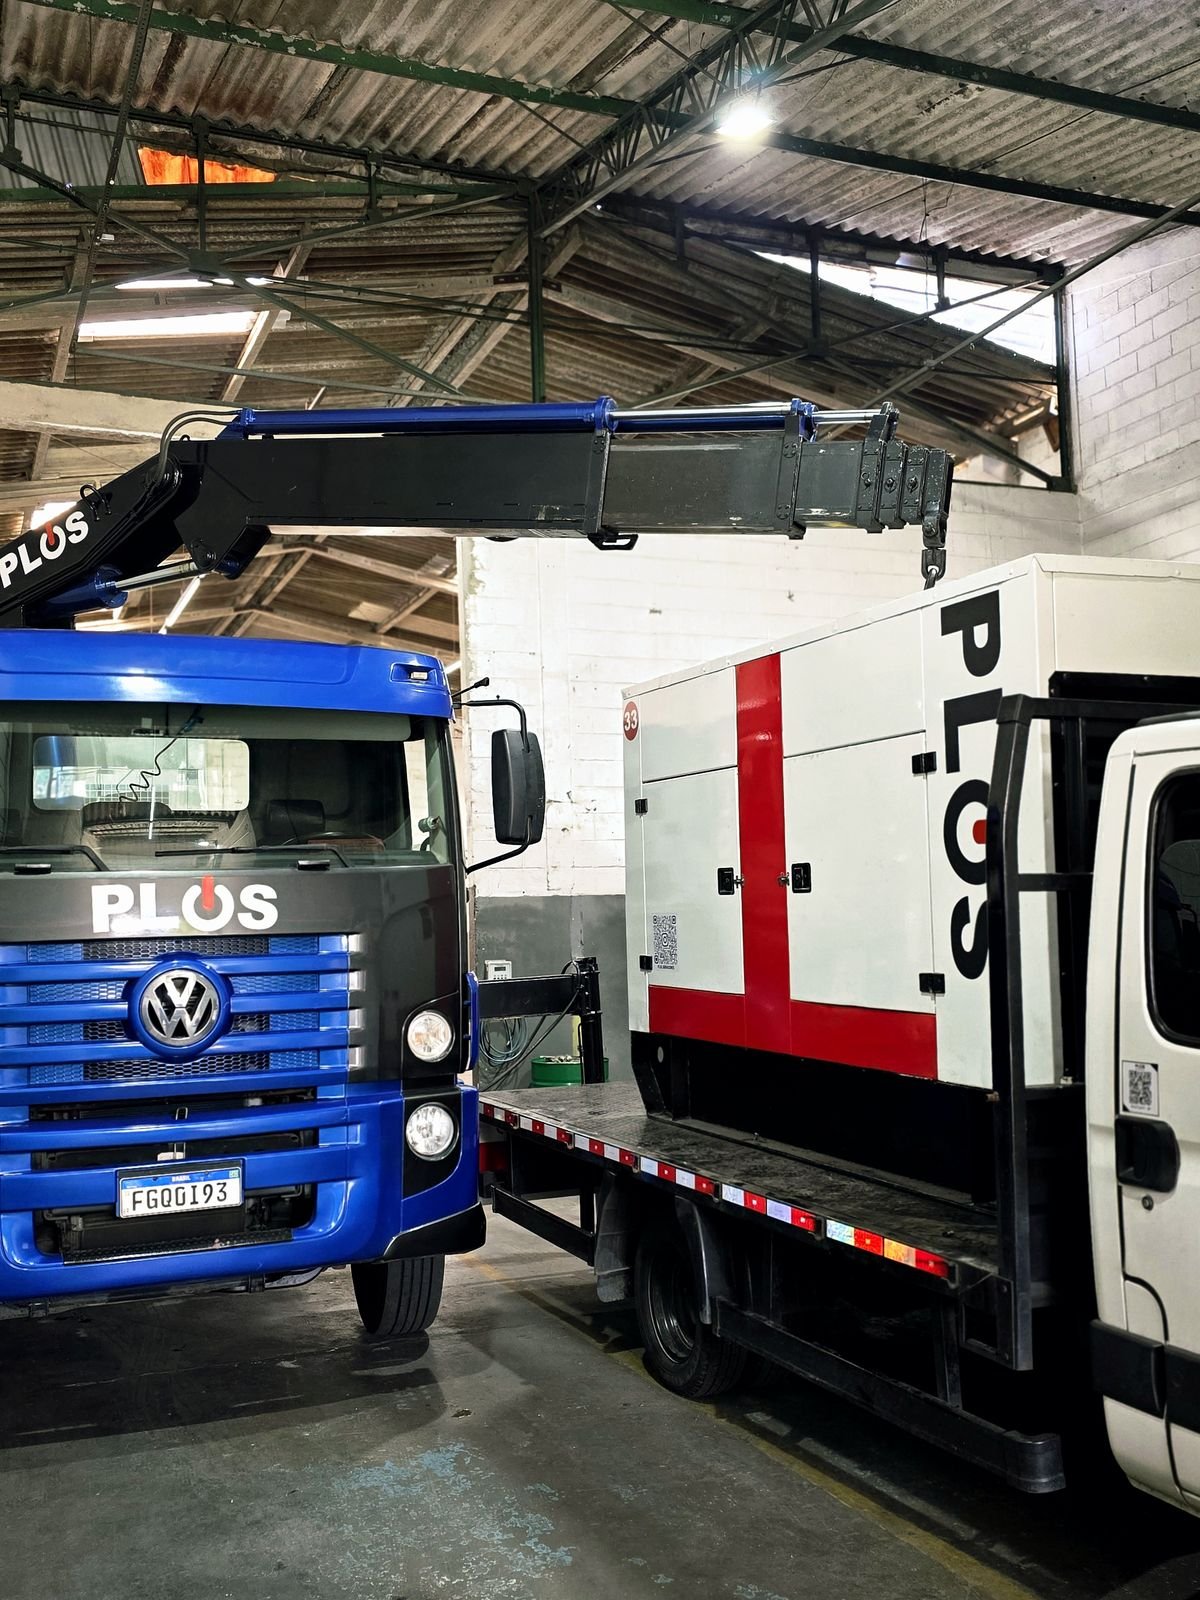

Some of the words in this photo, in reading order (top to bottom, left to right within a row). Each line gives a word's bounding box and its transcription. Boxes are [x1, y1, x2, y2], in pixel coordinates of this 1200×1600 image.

[0, 511, 89, 589] PLOS
[624, 710, 638, 731] 33
[941, 589, 1003, 980] PLOS
[91, 874, 279, 933] PLOS
